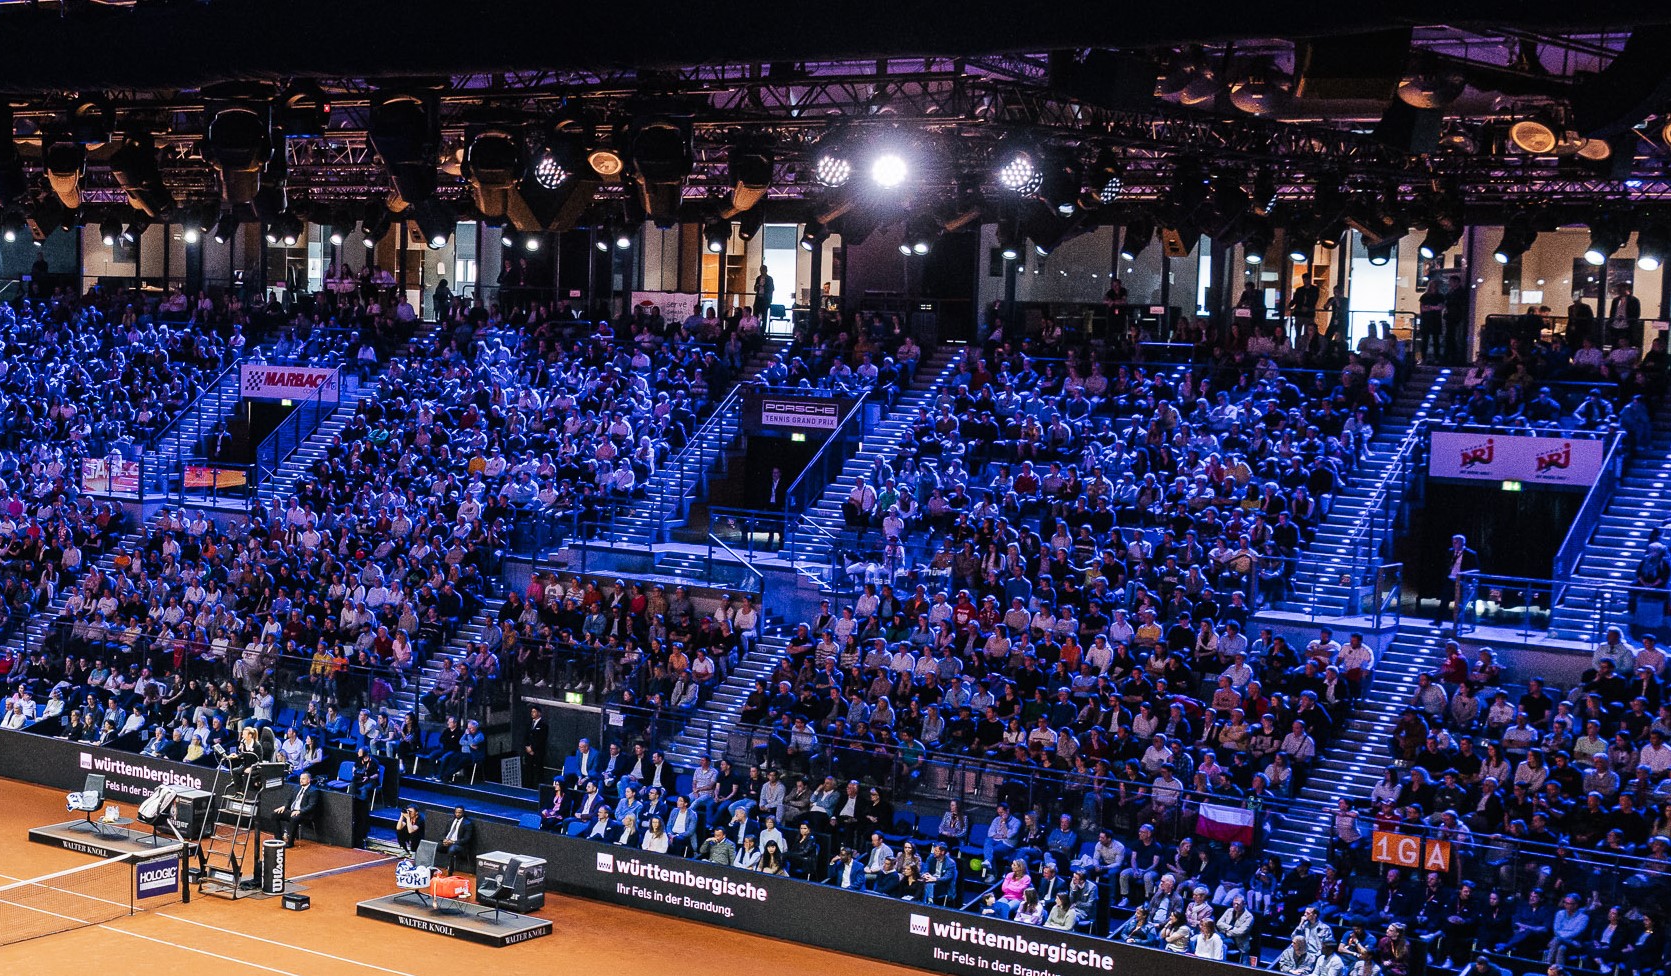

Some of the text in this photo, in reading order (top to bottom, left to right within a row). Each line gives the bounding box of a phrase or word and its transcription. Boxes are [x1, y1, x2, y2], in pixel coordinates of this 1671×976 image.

[765, 403, 835, 414] PORSCHE
[94, 757, 202, 789] württembergische
[105, 780, 120, 791] Fels
[121, 783, 128, 792] in
[129, 785, 142, 795] der
[62, 840, 108, 857] WALTER KNOLL
[140, 867, 177, 883] HOLOGIC
[272, 847, 284, 892] Wilson
[616, 859, 768, 901] württembergische
[616, 883, 734, 918] Ihr Fels in der Brandung.
[398, 916, 455, 936] WALTER KNOLL
[505, 928, 547, 944] WALTER KNOLL
[933, 921, 1114, 971] württembergische
[933, 947, 950, 961] Ihr
[952, 952, 976, 966] Fels
[978, 956, 989, 969] in
[991, 959, 1012, 973] der
